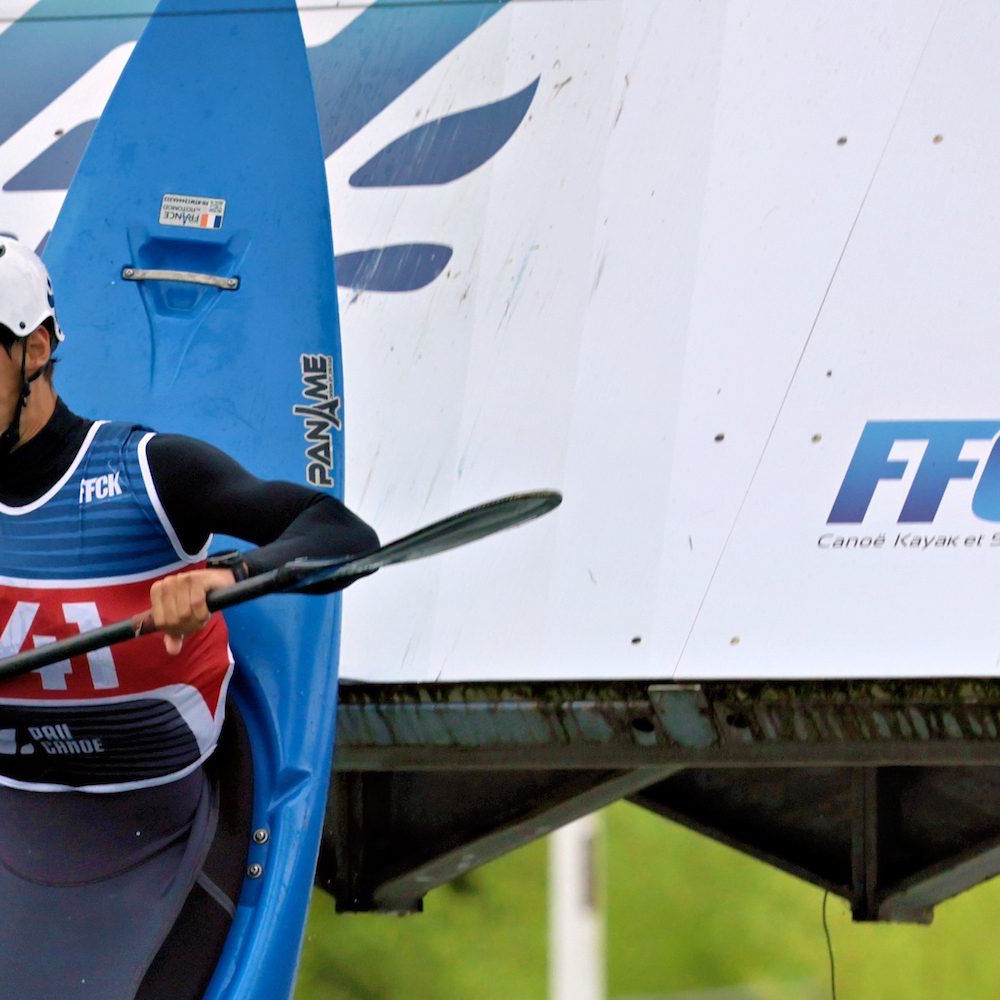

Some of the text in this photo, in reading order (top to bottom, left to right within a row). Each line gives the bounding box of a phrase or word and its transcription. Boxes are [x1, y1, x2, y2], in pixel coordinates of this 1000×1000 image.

[164, 210, 200, 225] FRANCE
[293, 353, 341, 487] PANAME
[817, 533, 886, 549] Canoë
[893, 532, 960, 551] Kayak
[963, 534, 984, 548] et
